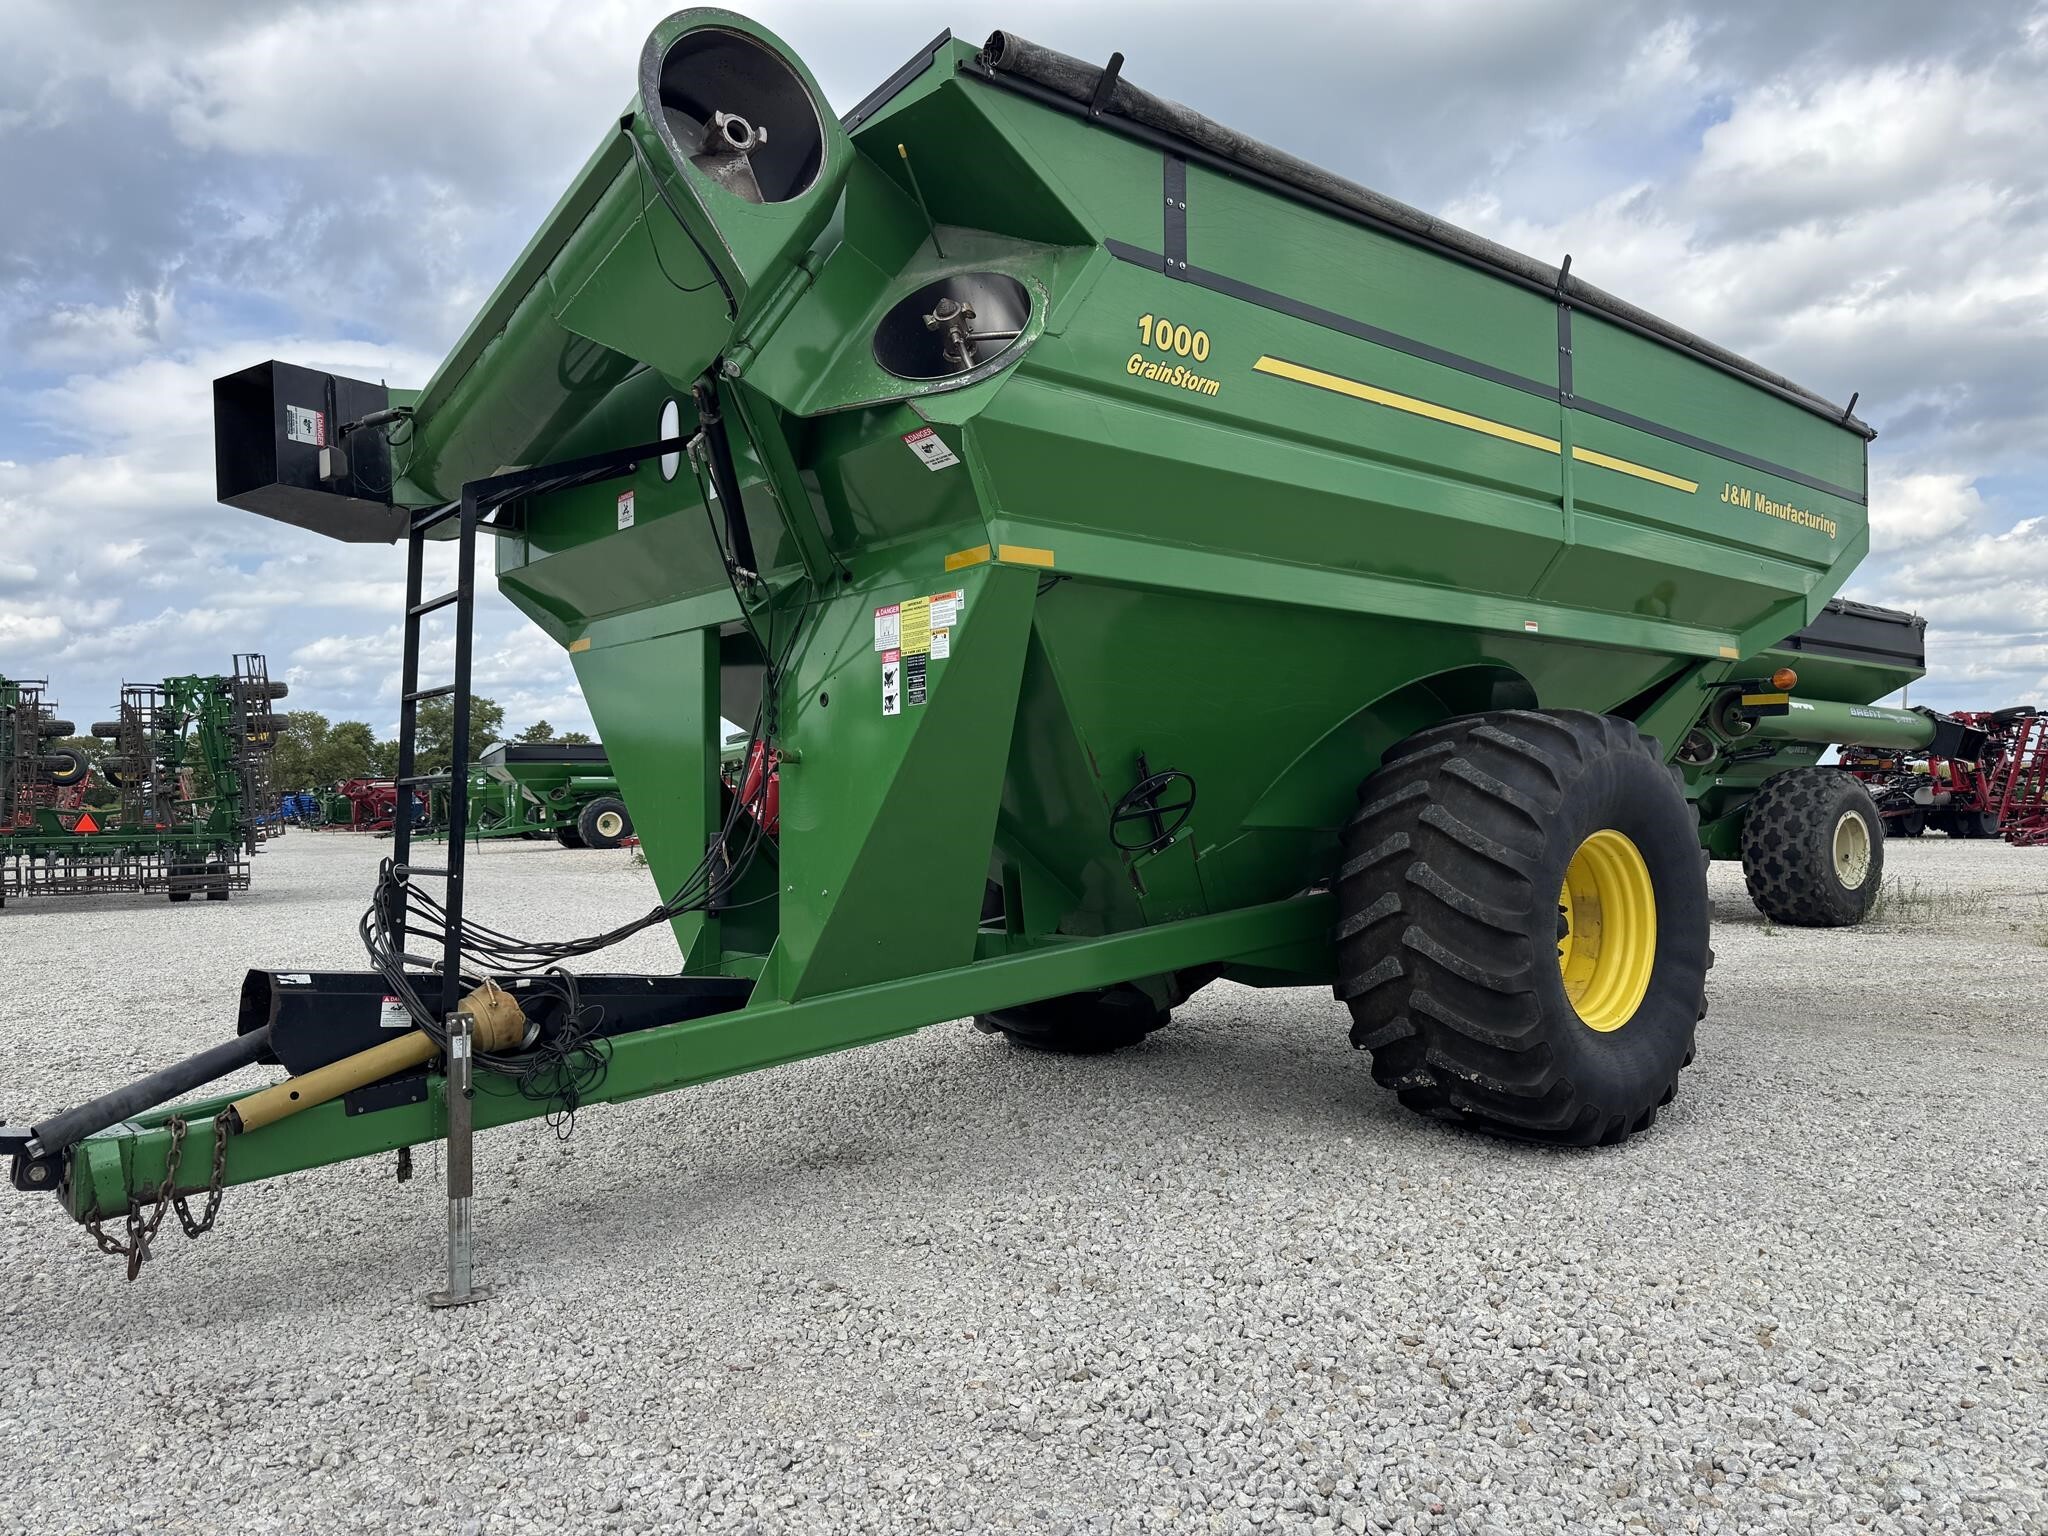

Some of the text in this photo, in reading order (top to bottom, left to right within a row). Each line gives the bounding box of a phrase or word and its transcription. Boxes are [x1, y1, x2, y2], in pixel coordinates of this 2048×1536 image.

[1137, 312, 1210, 363] 1000
[1126, 352, 1221, 397] GrainStorm
[317, 418, 325, 446] DANGER
[909, 428, 934, 442] DANGER
[1720, 482, 1837, 540] J&M Manufacturing
[880, 606, 899, 616] DANGER
